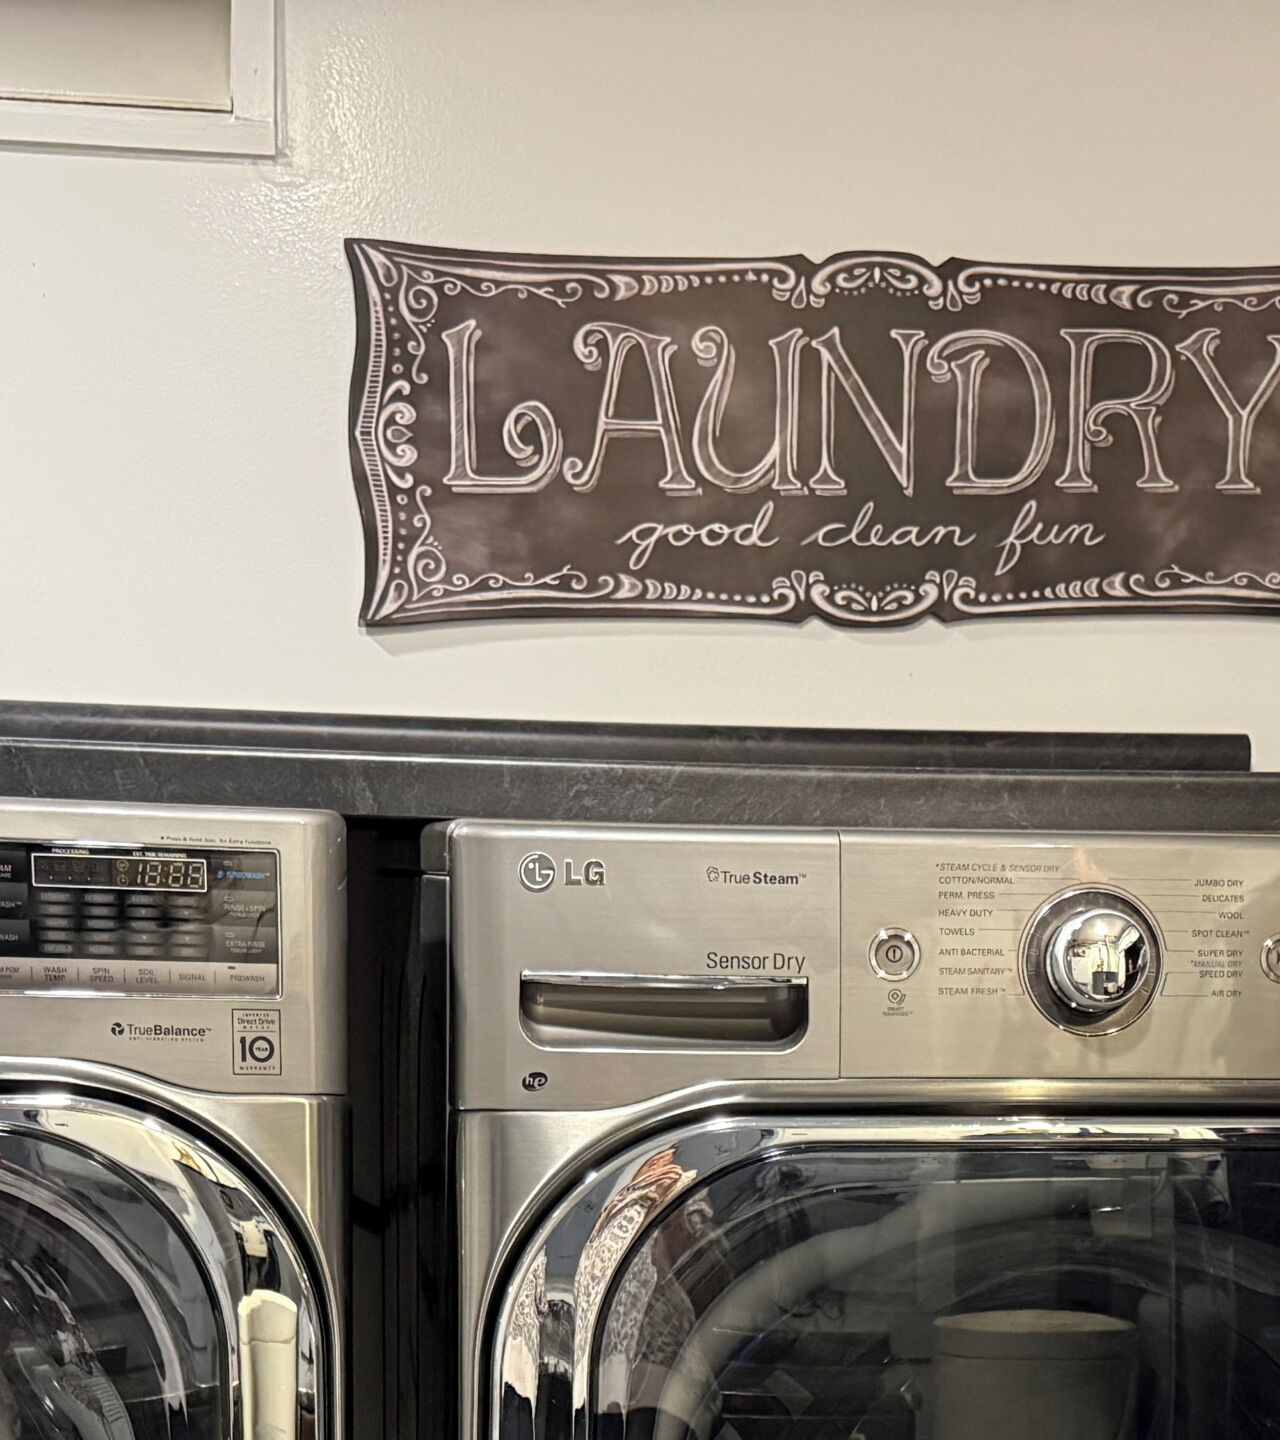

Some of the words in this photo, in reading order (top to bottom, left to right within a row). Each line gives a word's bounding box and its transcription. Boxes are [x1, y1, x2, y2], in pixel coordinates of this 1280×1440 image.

[616, 501, 777, 571] good
[801, 501, 975, 549] clean
[990, 501, 1106, 575] fun
[971, 864, 998, 872] CYCLE
[1008, 865, 1042, 873] SENSOR
[1043, 865, 1060, 873] DRY
[564, 859, 606, 887] LG
[939, 876, 1015, 885] COTTON/NORMAL
[1194, 879, 1225, 887] JUMBO
[1227, 879, 1244, 887] DRY
[968, 892, 995, 900] PRESS
[1202, 895, 1244, 903] DELICATES
[939, 909, 967, 917] HEAVY
[970, 909, 993, 917] DUTY
[1218, 911, 1244, 920] WOOL
[939, 928, 975, 936] TOWELS
[1192, 930, 1213, 938] SPOT
[939, 948, 959, 956] ANTI
[960, 948, 1005, 957] BACTERIAL
[1197, 950, 1225, 958] SUPER
[1226, 950, 1243, 958] DRY
[706, 951, 769, 970] Sensor
[773, 952, 806, 974] Dry
[939, 968, 965, 976] STEAM
[1199, 970, 1225, 978] SPEED
[1227, 970, 1243, 978] DRY
[178, 973, 207, 981] SIGNAL
[938, 988, 968, 996] STEAM
[1211, 990, 1224, 998] AIR
[1226, 990, 1243, 998] DRY
[237, 1017, 257, 1025] Direct
[239, 1035, 275, 1063] 10
